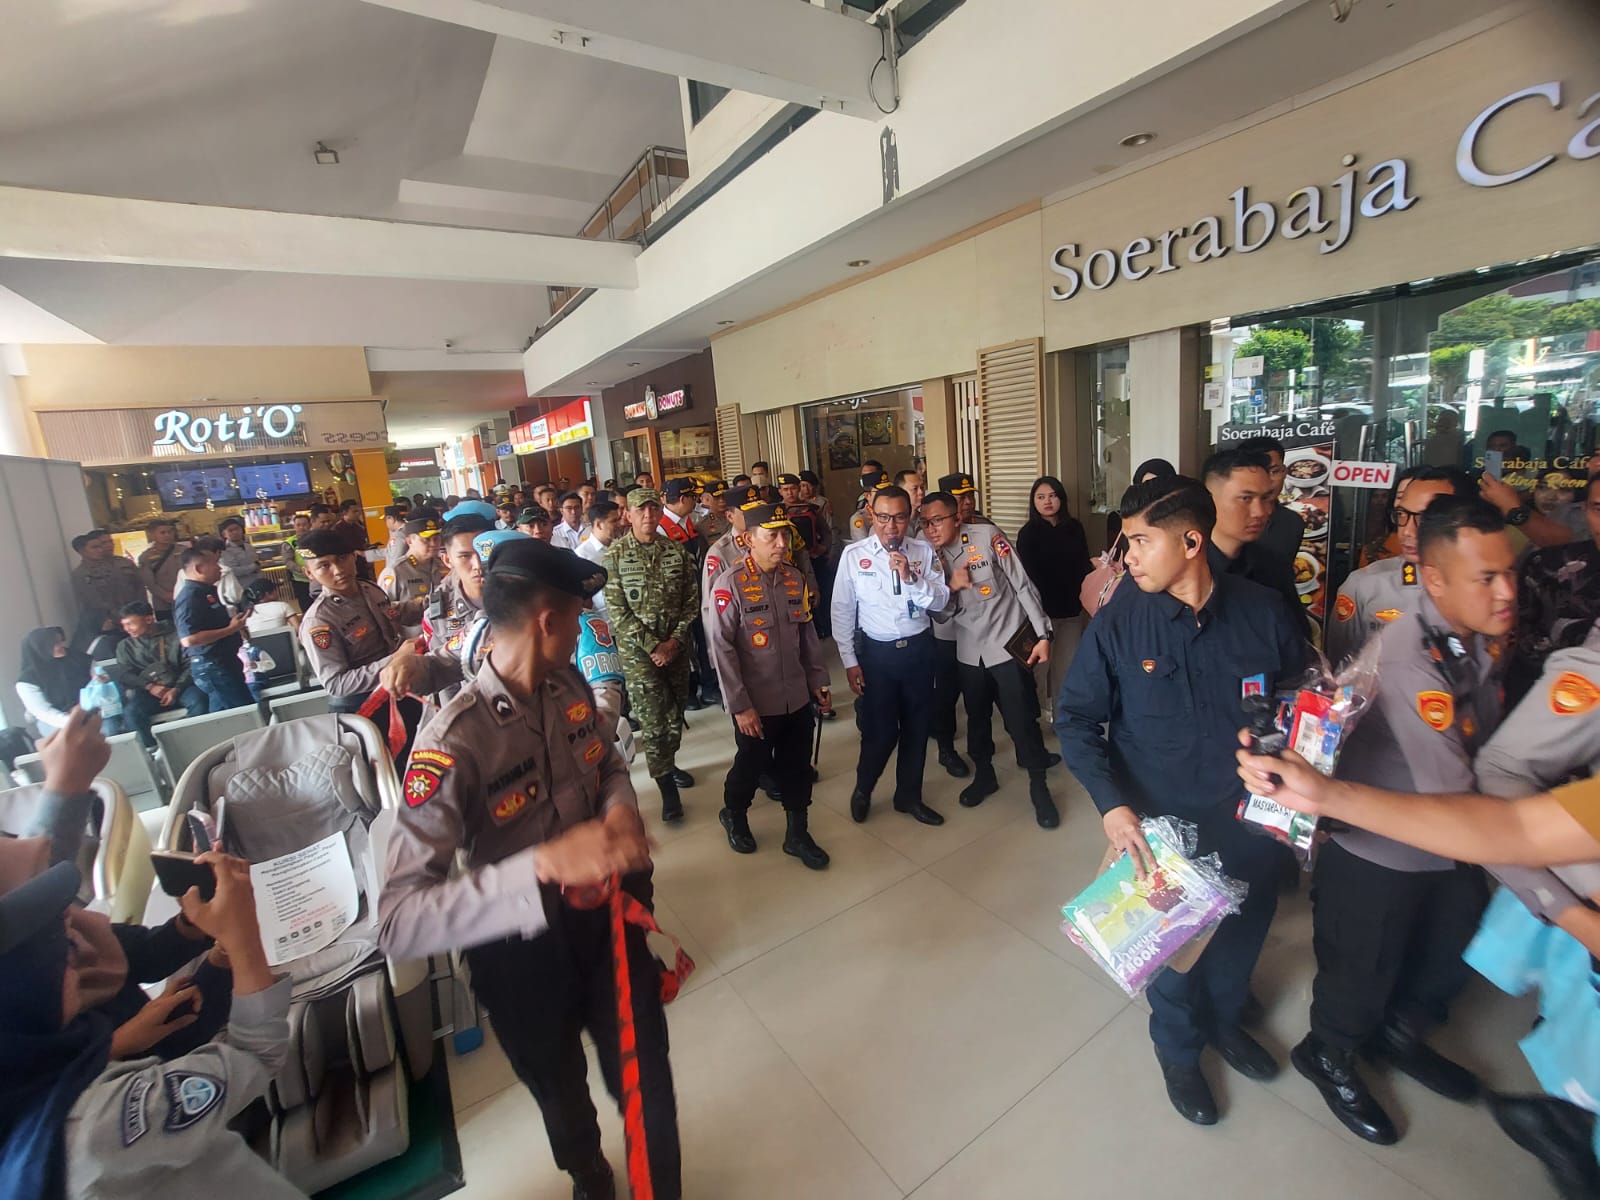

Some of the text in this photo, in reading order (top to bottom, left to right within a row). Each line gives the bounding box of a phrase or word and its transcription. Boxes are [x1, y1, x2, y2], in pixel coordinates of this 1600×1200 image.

[1050, 153, 1420, 300] Soerabaja
[658, 390, 684, 411] DONUTS
[1222, 422, 1336, 441] Soerabaja Café
[1333, 465, 1390, 483] OPEN
[1474, 457, 1548, 473] Srabaja
[1127, 942, 1161, 974] BOOK
